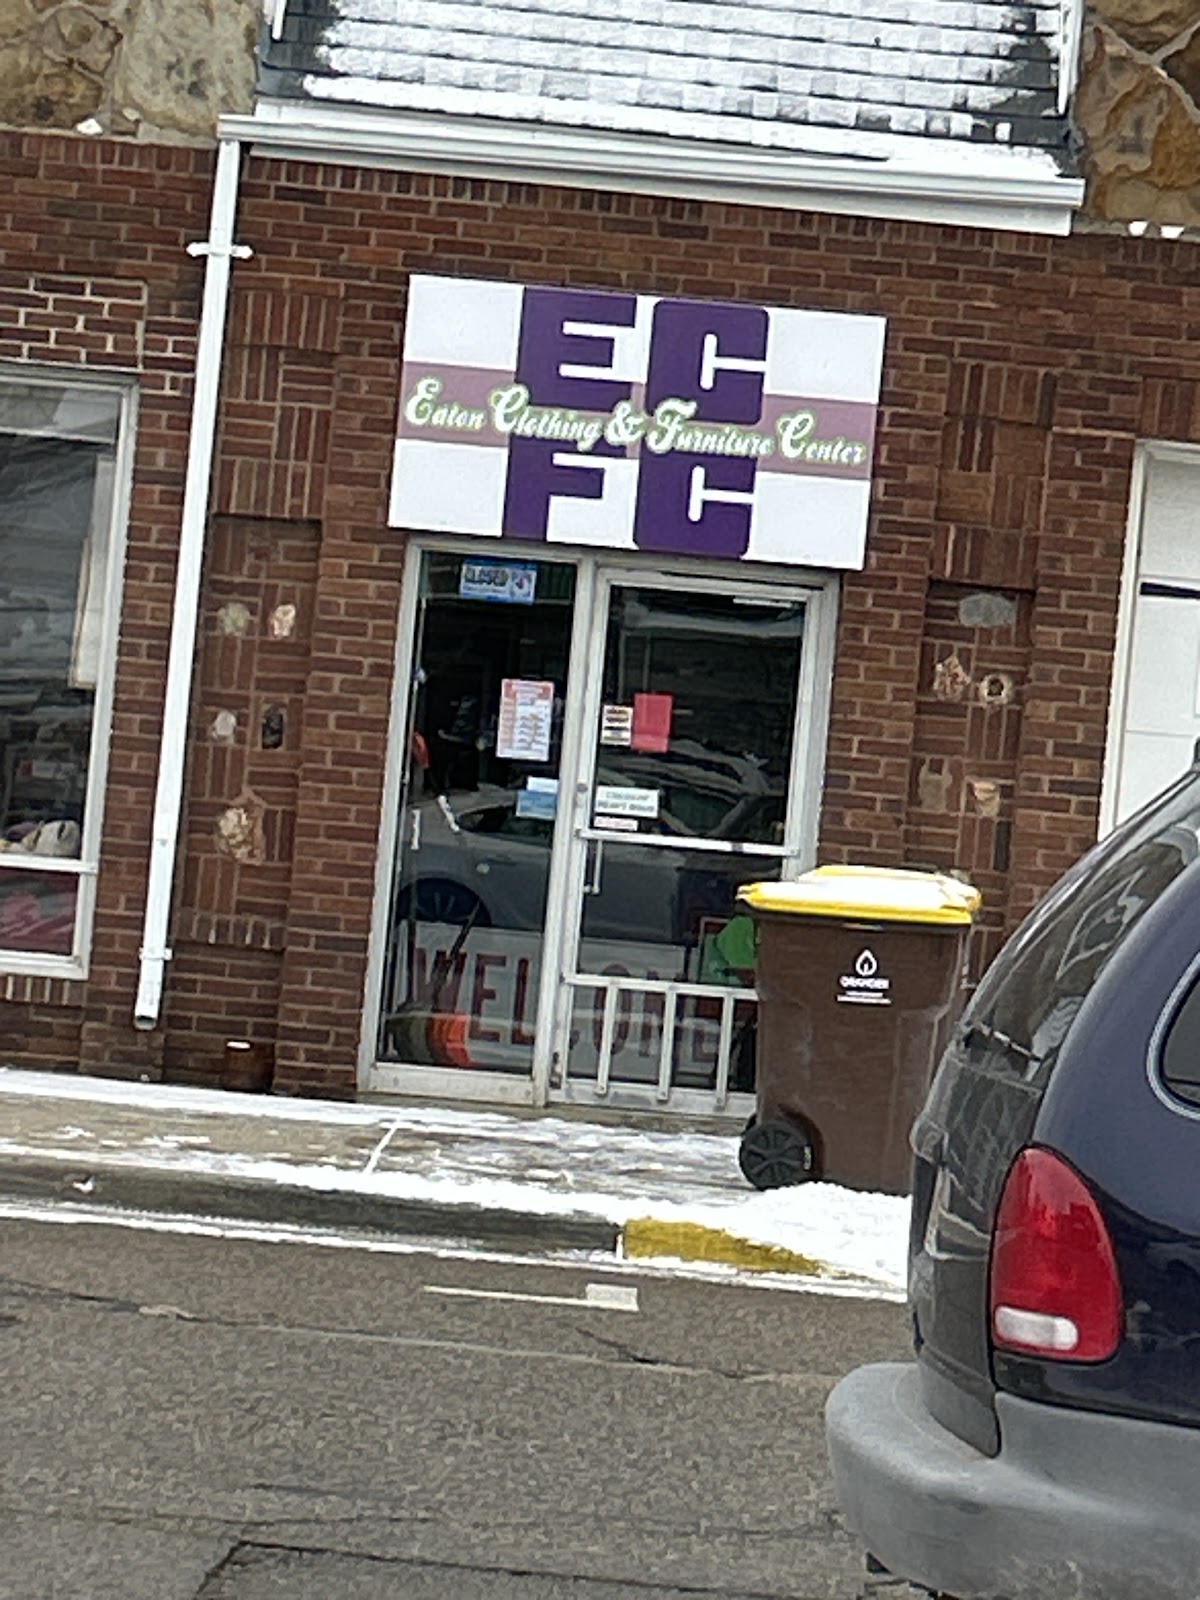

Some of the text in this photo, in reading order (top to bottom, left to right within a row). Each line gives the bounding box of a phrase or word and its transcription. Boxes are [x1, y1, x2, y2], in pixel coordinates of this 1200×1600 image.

[513, 285, 769, 425] EC
[404, 375, 867, 465] Eaton Clothing & Furniture Center
[502, 434, 757, 559] FC
[408, 946, 722, 1064] WELOME
